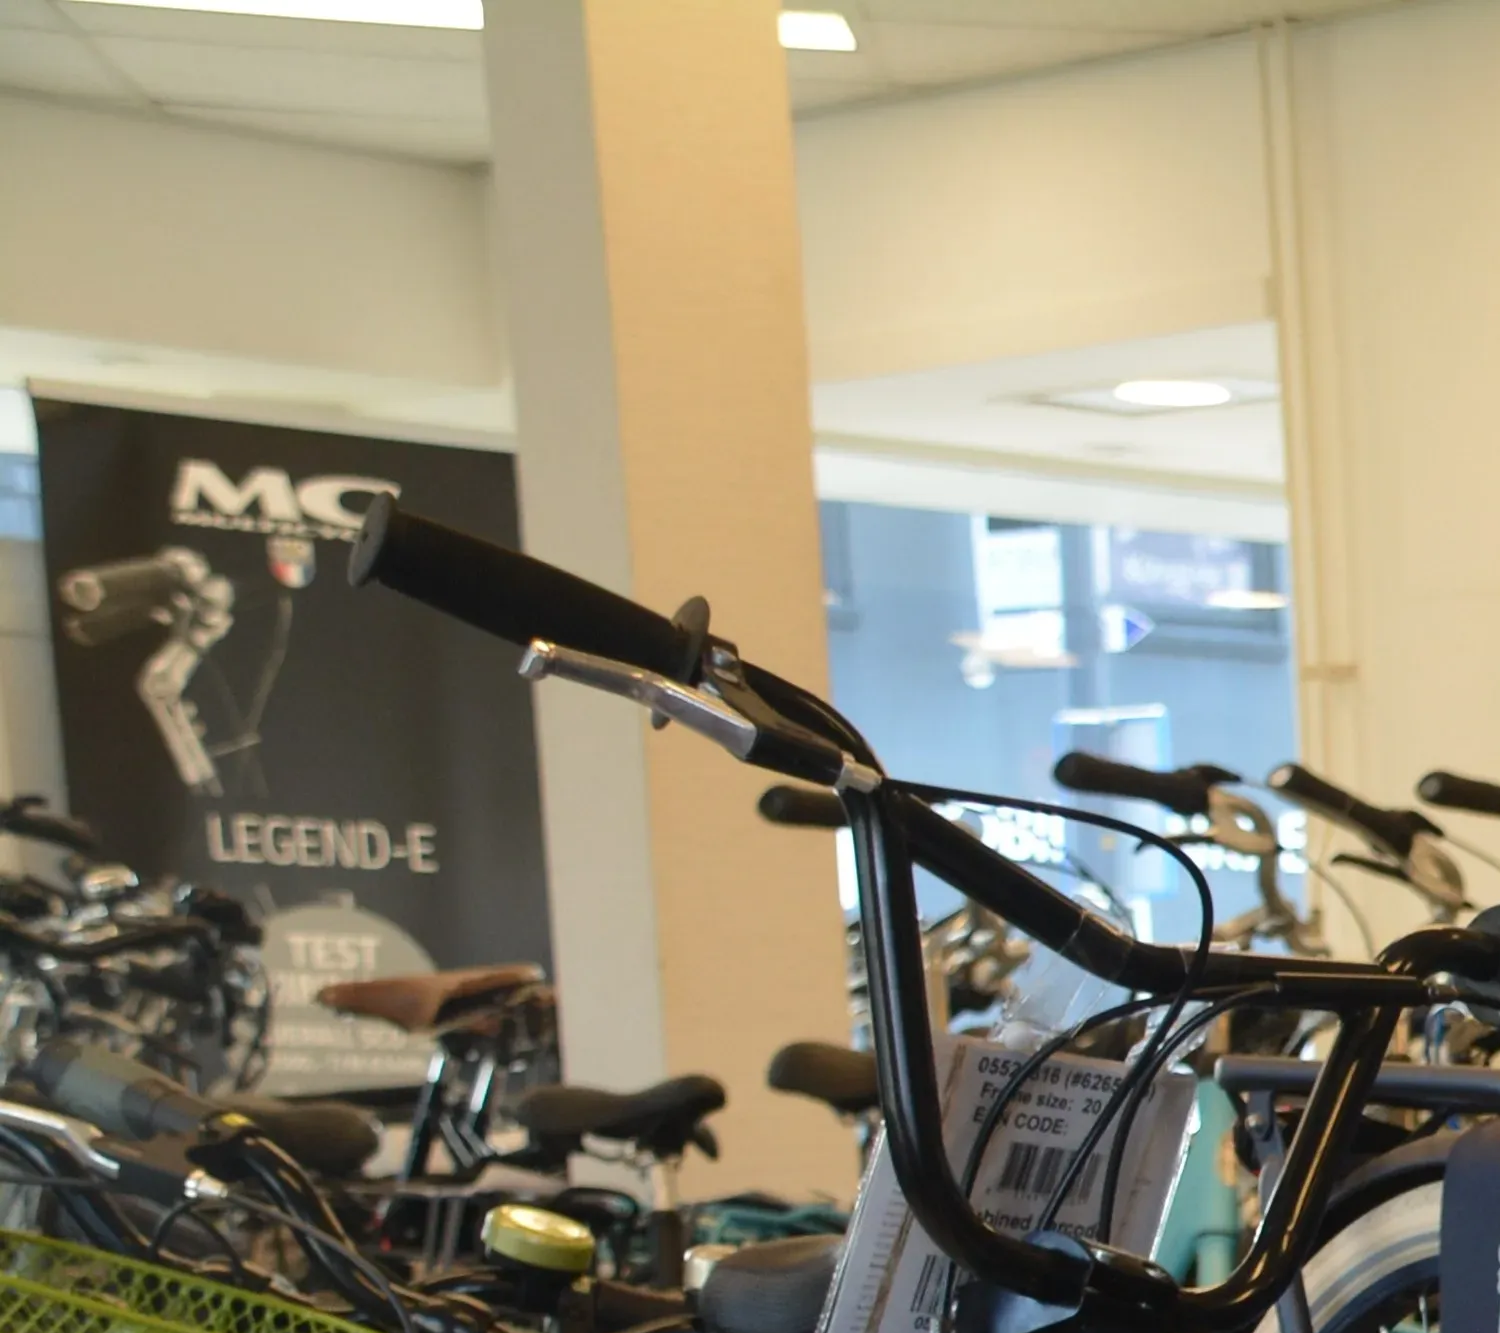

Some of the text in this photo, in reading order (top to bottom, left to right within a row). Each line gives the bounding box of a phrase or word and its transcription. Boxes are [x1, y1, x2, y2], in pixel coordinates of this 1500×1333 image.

[205, 812, 440, 873] LEGEND-E
[285, 935, 382, 971] TEST
[980, 1082, 1032, 1105] Frme
[1036, 1092, 1073, 1112] size:
[1014, 1113, 1069, 1137] CODE:
